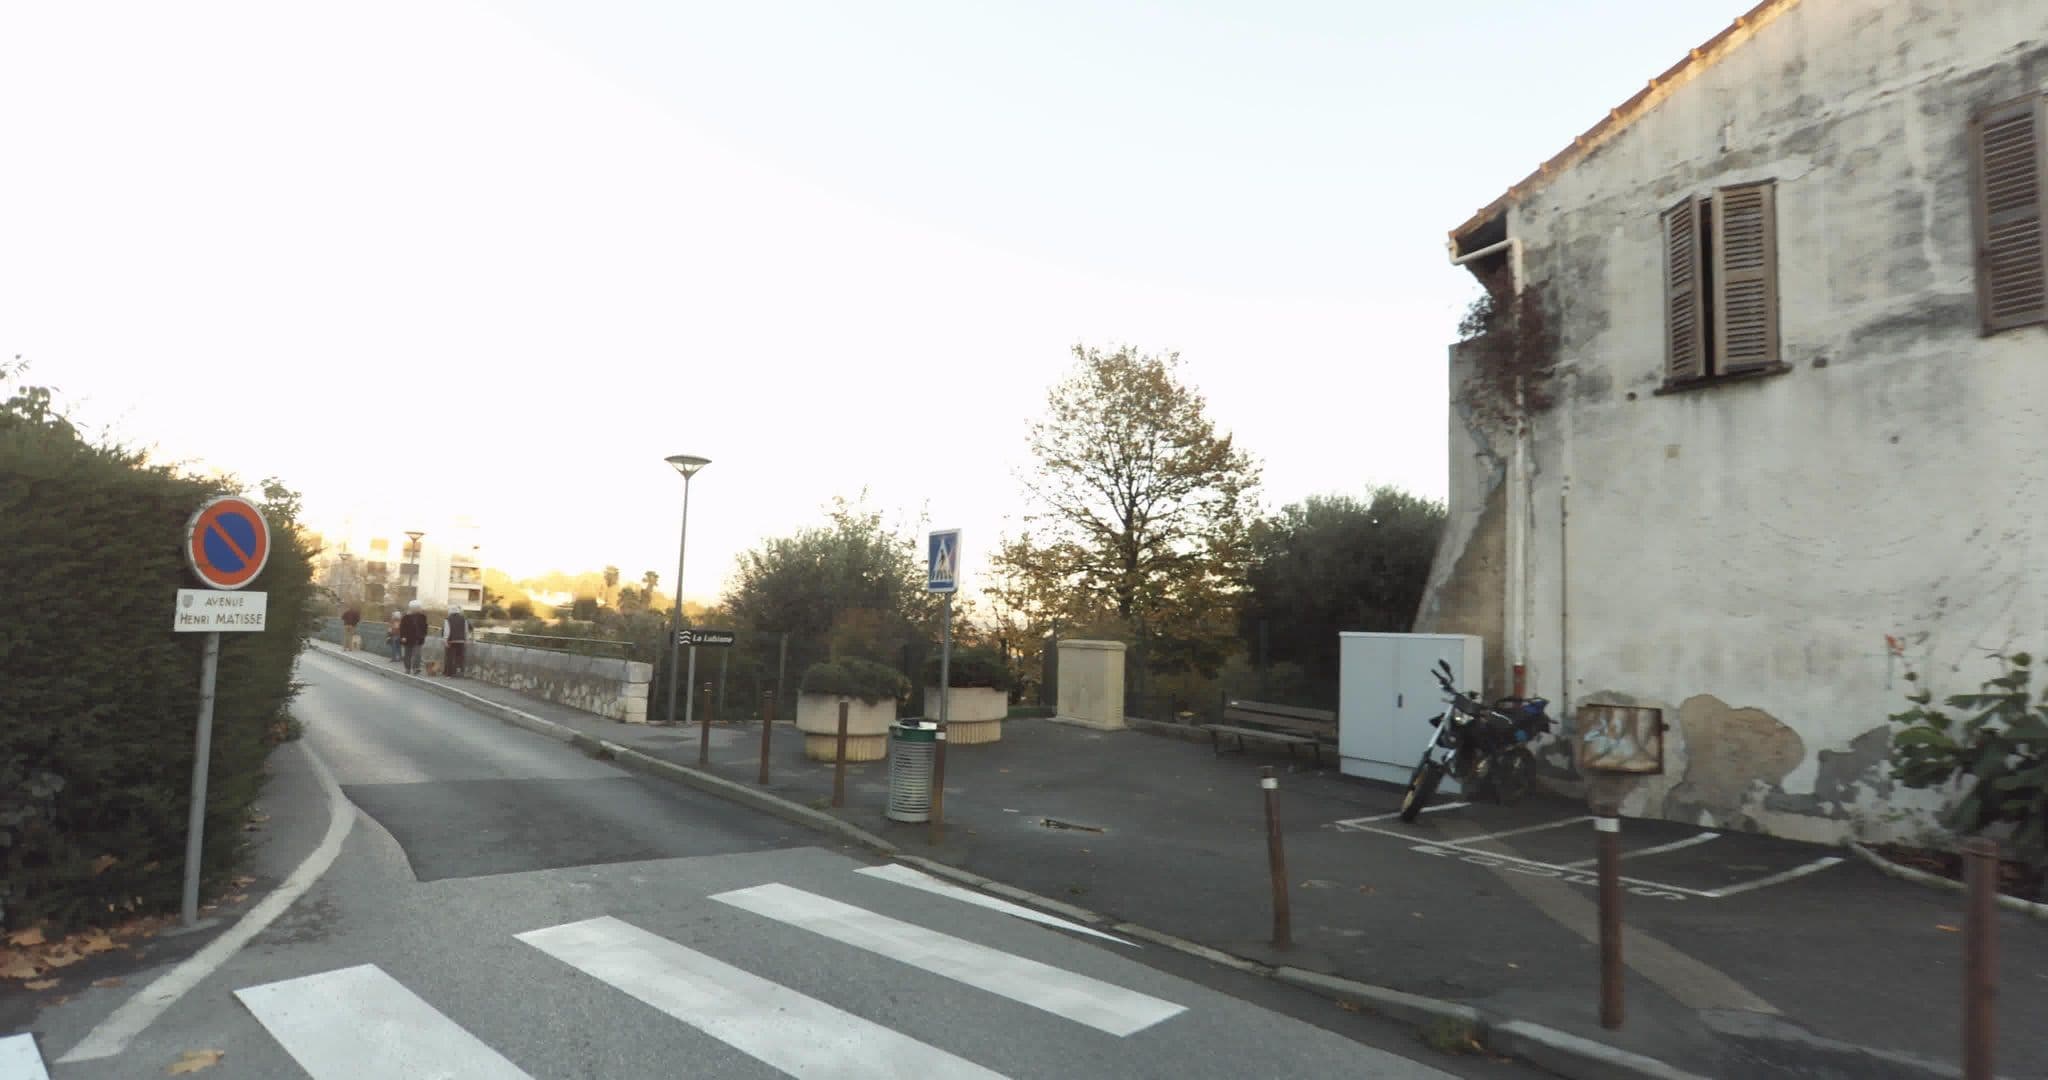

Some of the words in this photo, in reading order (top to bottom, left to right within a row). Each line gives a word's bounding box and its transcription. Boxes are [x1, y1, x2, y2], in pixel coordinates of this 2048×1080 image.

[205, 596, 244, 607] AVENUE
[179, 613, 211, 624] HENRI
[215, 613, 263, 625] MATISSE
